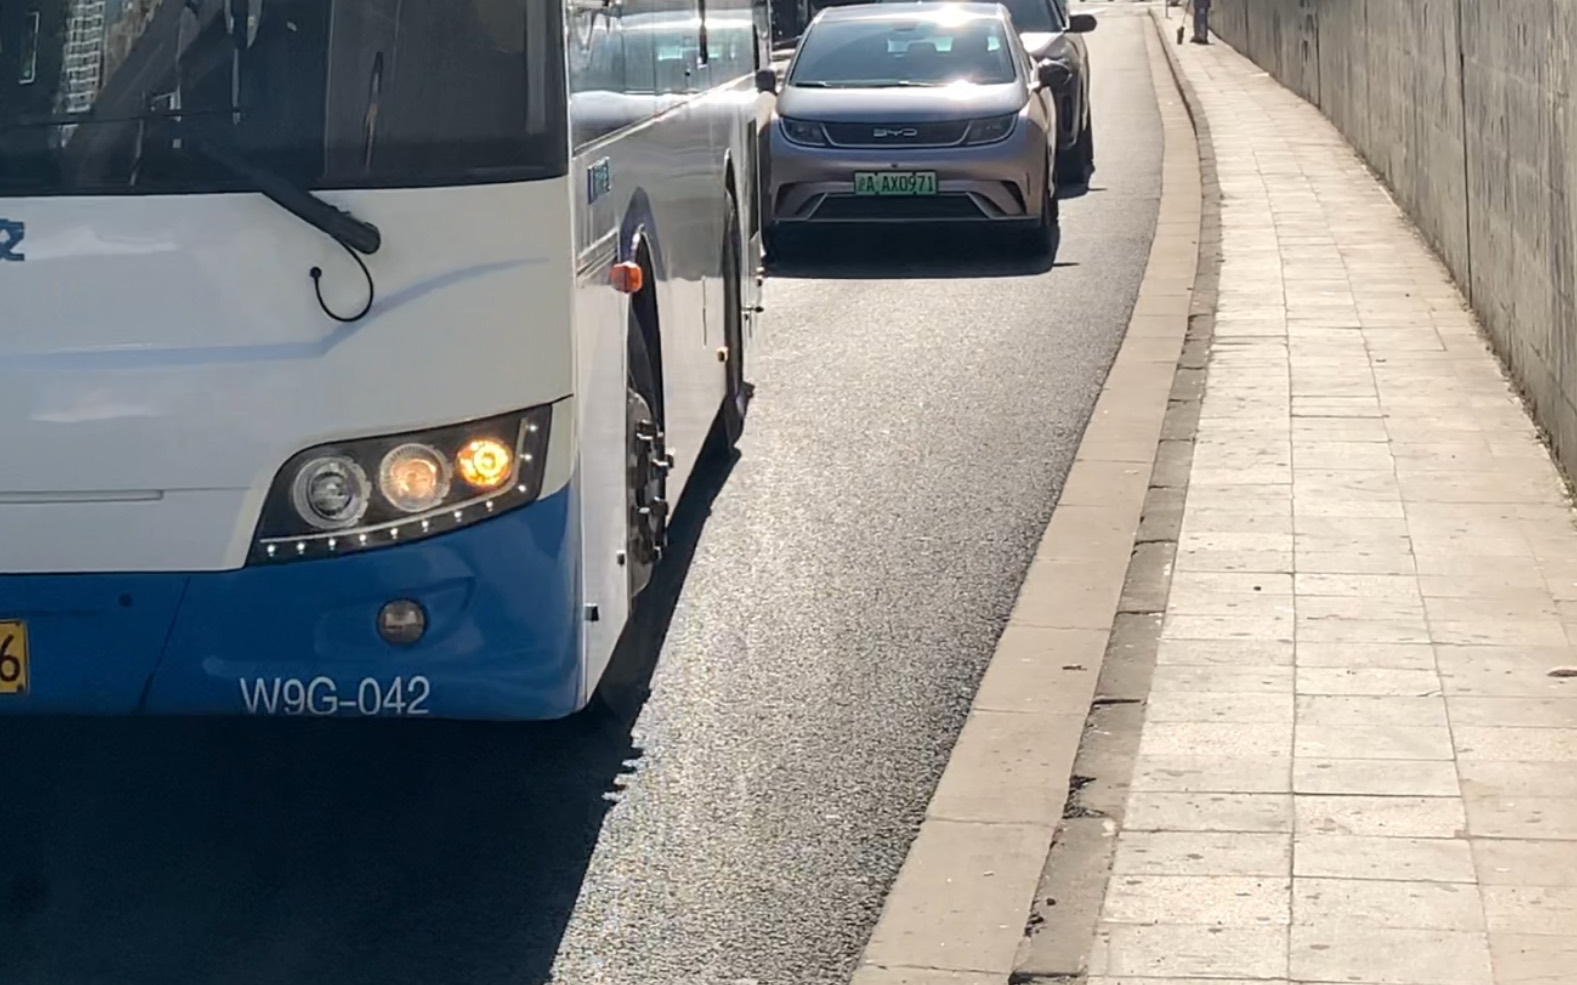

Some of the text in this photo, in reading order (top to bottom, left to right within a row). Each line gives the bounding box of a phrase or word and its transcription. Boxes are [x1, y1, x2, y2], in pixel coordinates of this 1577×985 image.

[873, 128, 918, 137] BYD
[882, 174, 934, 193] AX0971
[239, 676, 430, 715] W9G-042
